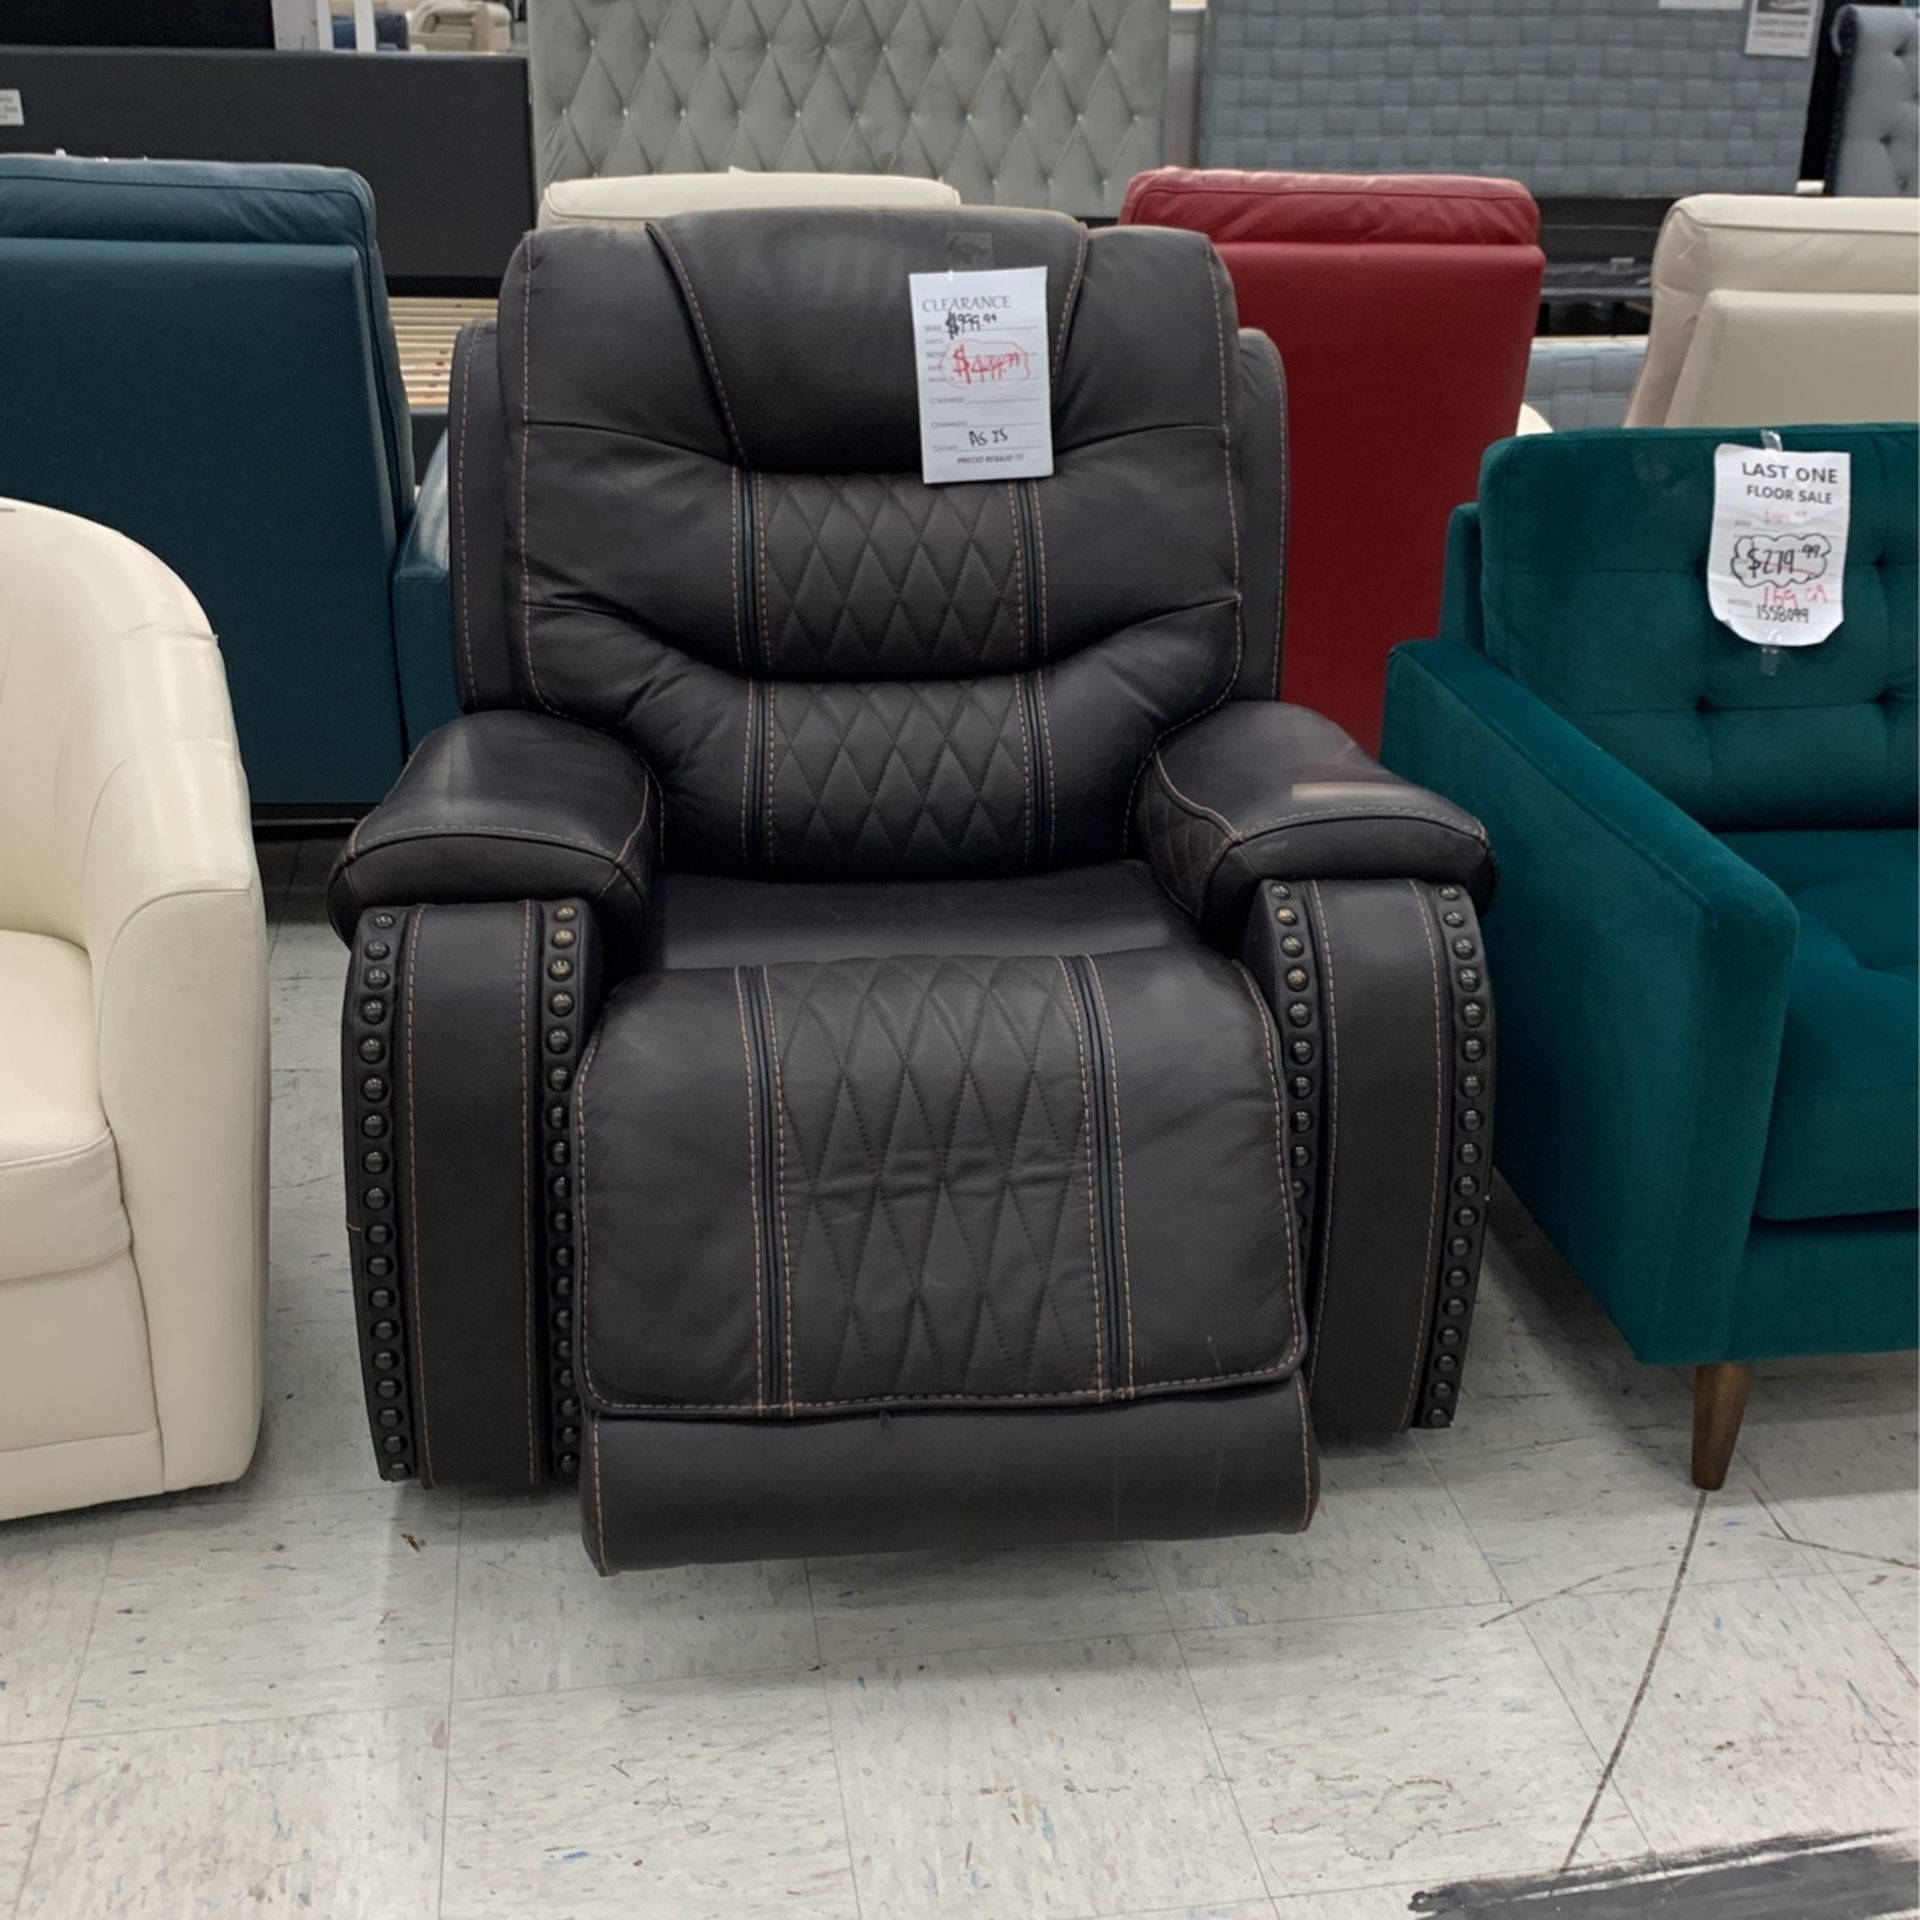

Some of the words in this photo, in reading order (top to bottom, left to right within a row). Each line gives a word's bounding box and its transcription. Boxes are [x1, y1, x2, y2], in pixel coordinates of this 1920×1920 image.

[922, 295, 1012, 313] CLEARANCE
[968, 430, 988, 447] AS
[1742, 462, 1789, 480] LAST
[1796, 467, 1838, 484] ONE
[1746, 484, 1794, 502] FLOOR
[1798, 490, 1832, 505] SALE
